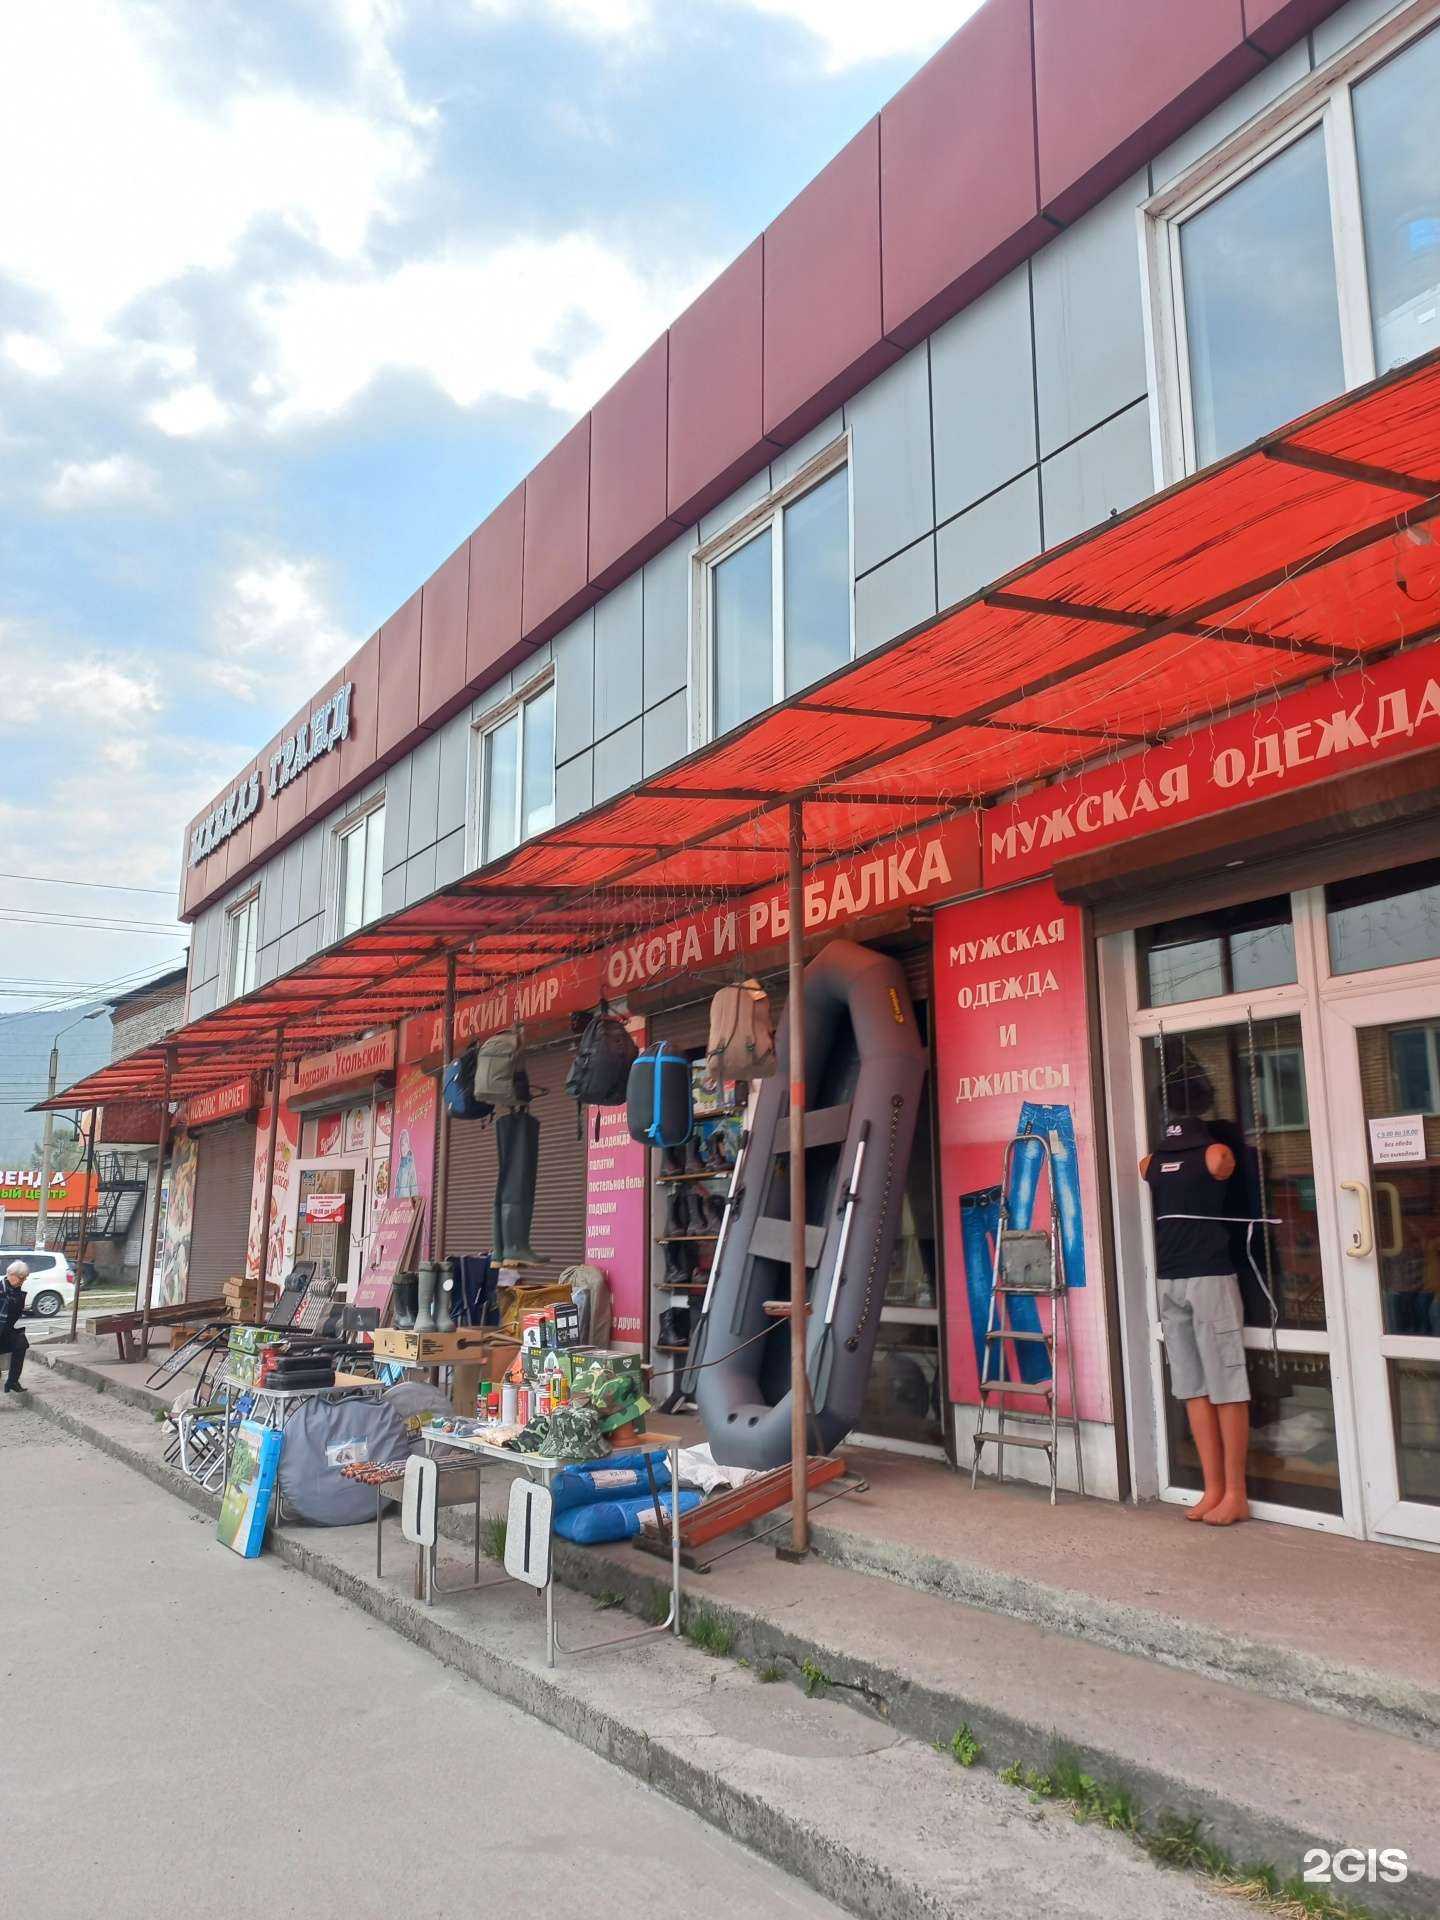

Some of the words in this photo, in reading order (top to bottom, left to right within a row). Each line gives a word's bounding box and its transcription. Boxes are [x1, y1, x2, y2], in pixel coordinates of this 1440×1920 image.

[991, 764, 1191, 865] МУЖСКАЯ
[1212, 678, 1440, 788] ОДЕЖДА
[607, 925, 703, 988] ОХОТА
[713, 913, 736, 956] И
[949, 918, 1065, 967] МУЖСКАЯ
[957, 969, 1060, 1010] ОДЕЖДА
[430, 988, 508, 1053] ДТСКИЙ
[513, 977, 559, 1021] МИР
[999, 1023, 1017, 1048] И
[956, 1063, 1070, 1104] ДЖИНСЫ
[218, 1085, 245, 1113] МАРКЕТ
[589, 1158, 615, 1170] палатки
[25, 1188, 68, 1200] ЦЕТР
[588, 1179, 625, 1193] постельное
[588, 1202, 617, 1215] подушки
[587, 1247, 615, 1259] катушки
[617, 1316, 641, 1330] другое
